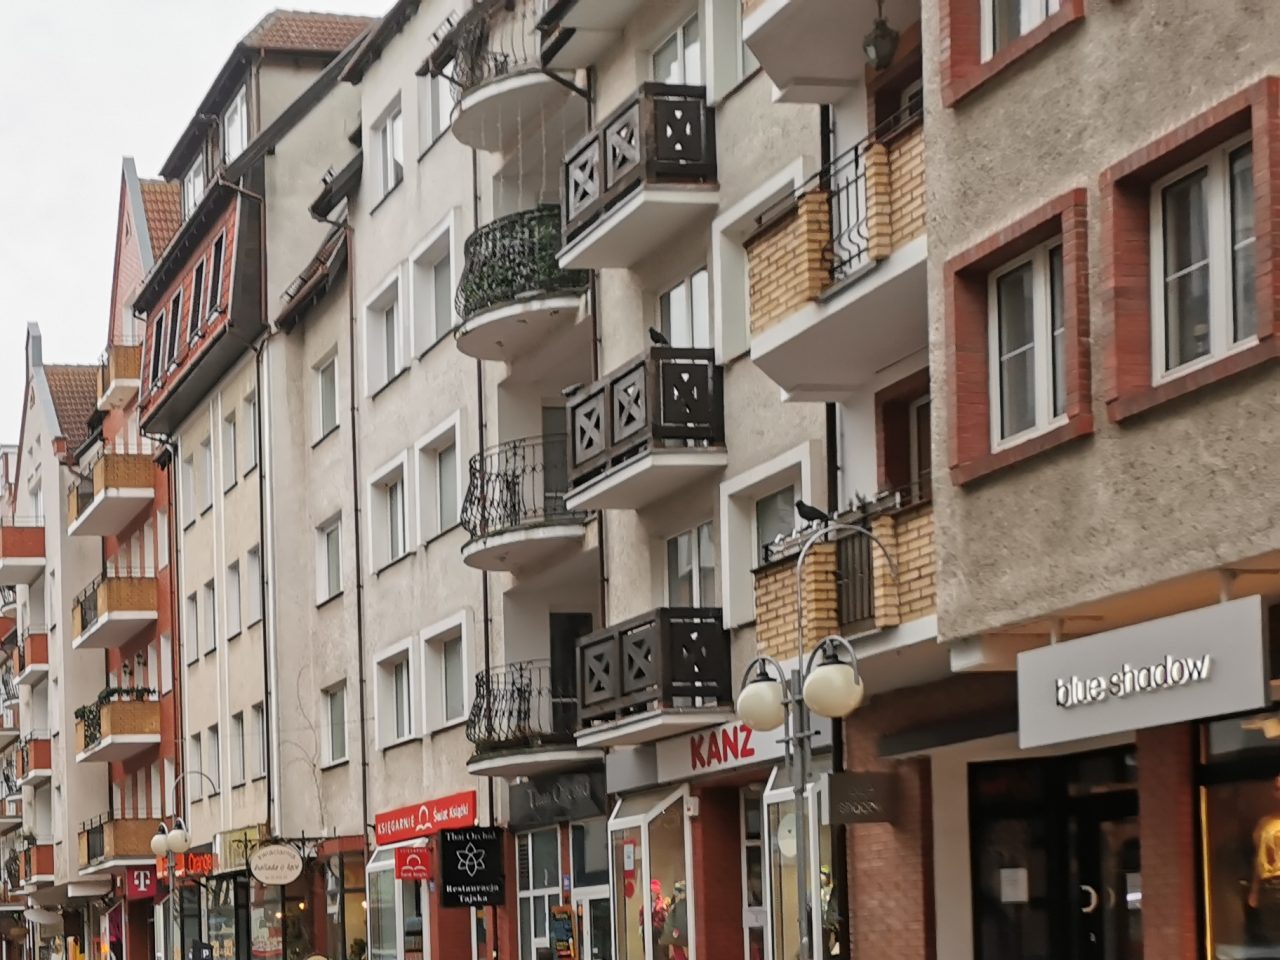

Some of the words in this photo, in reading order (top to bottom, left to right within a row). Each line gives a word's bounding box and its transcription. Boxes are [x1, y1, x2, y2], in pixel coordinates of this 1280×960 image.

[1055, 676, 1107, 709] blue
[1108, 653, 1211, 699] shadow
[690, 724, 755, 771] KANZ
[445, 831, 464, 841] Thai
[466, 832, 497, 841] Orchid
[188, 852, 213, 877] Orange
[133, 870, 151, 891] T
[446, 884, 499, 893] Restauracja
[458, 894, 488, 903] Tajska
